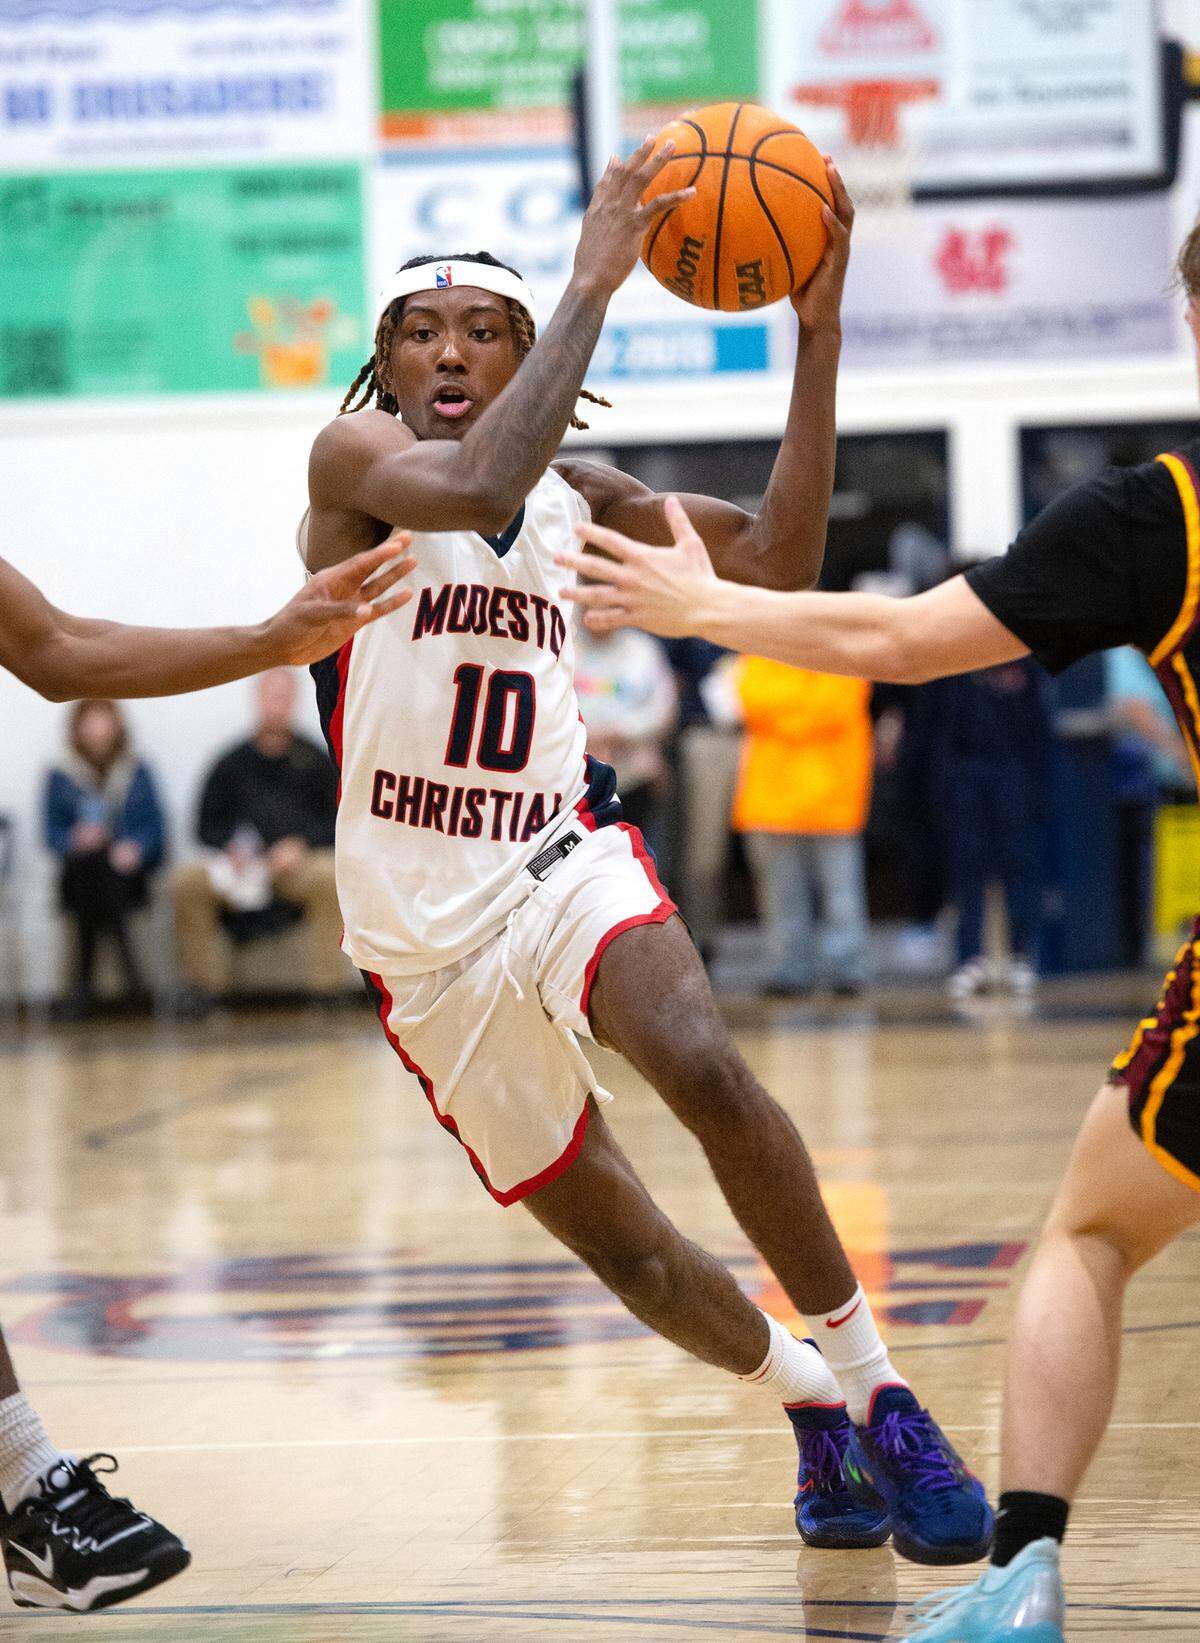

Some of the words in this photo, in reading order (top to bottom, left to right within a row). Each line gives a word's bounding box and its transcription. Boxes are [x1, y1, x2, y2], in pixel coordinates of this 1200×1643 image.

[737, 260, 766, 307] CAA
[444, 662, 536, 773] 10
[564, 840, 576, 852] M
